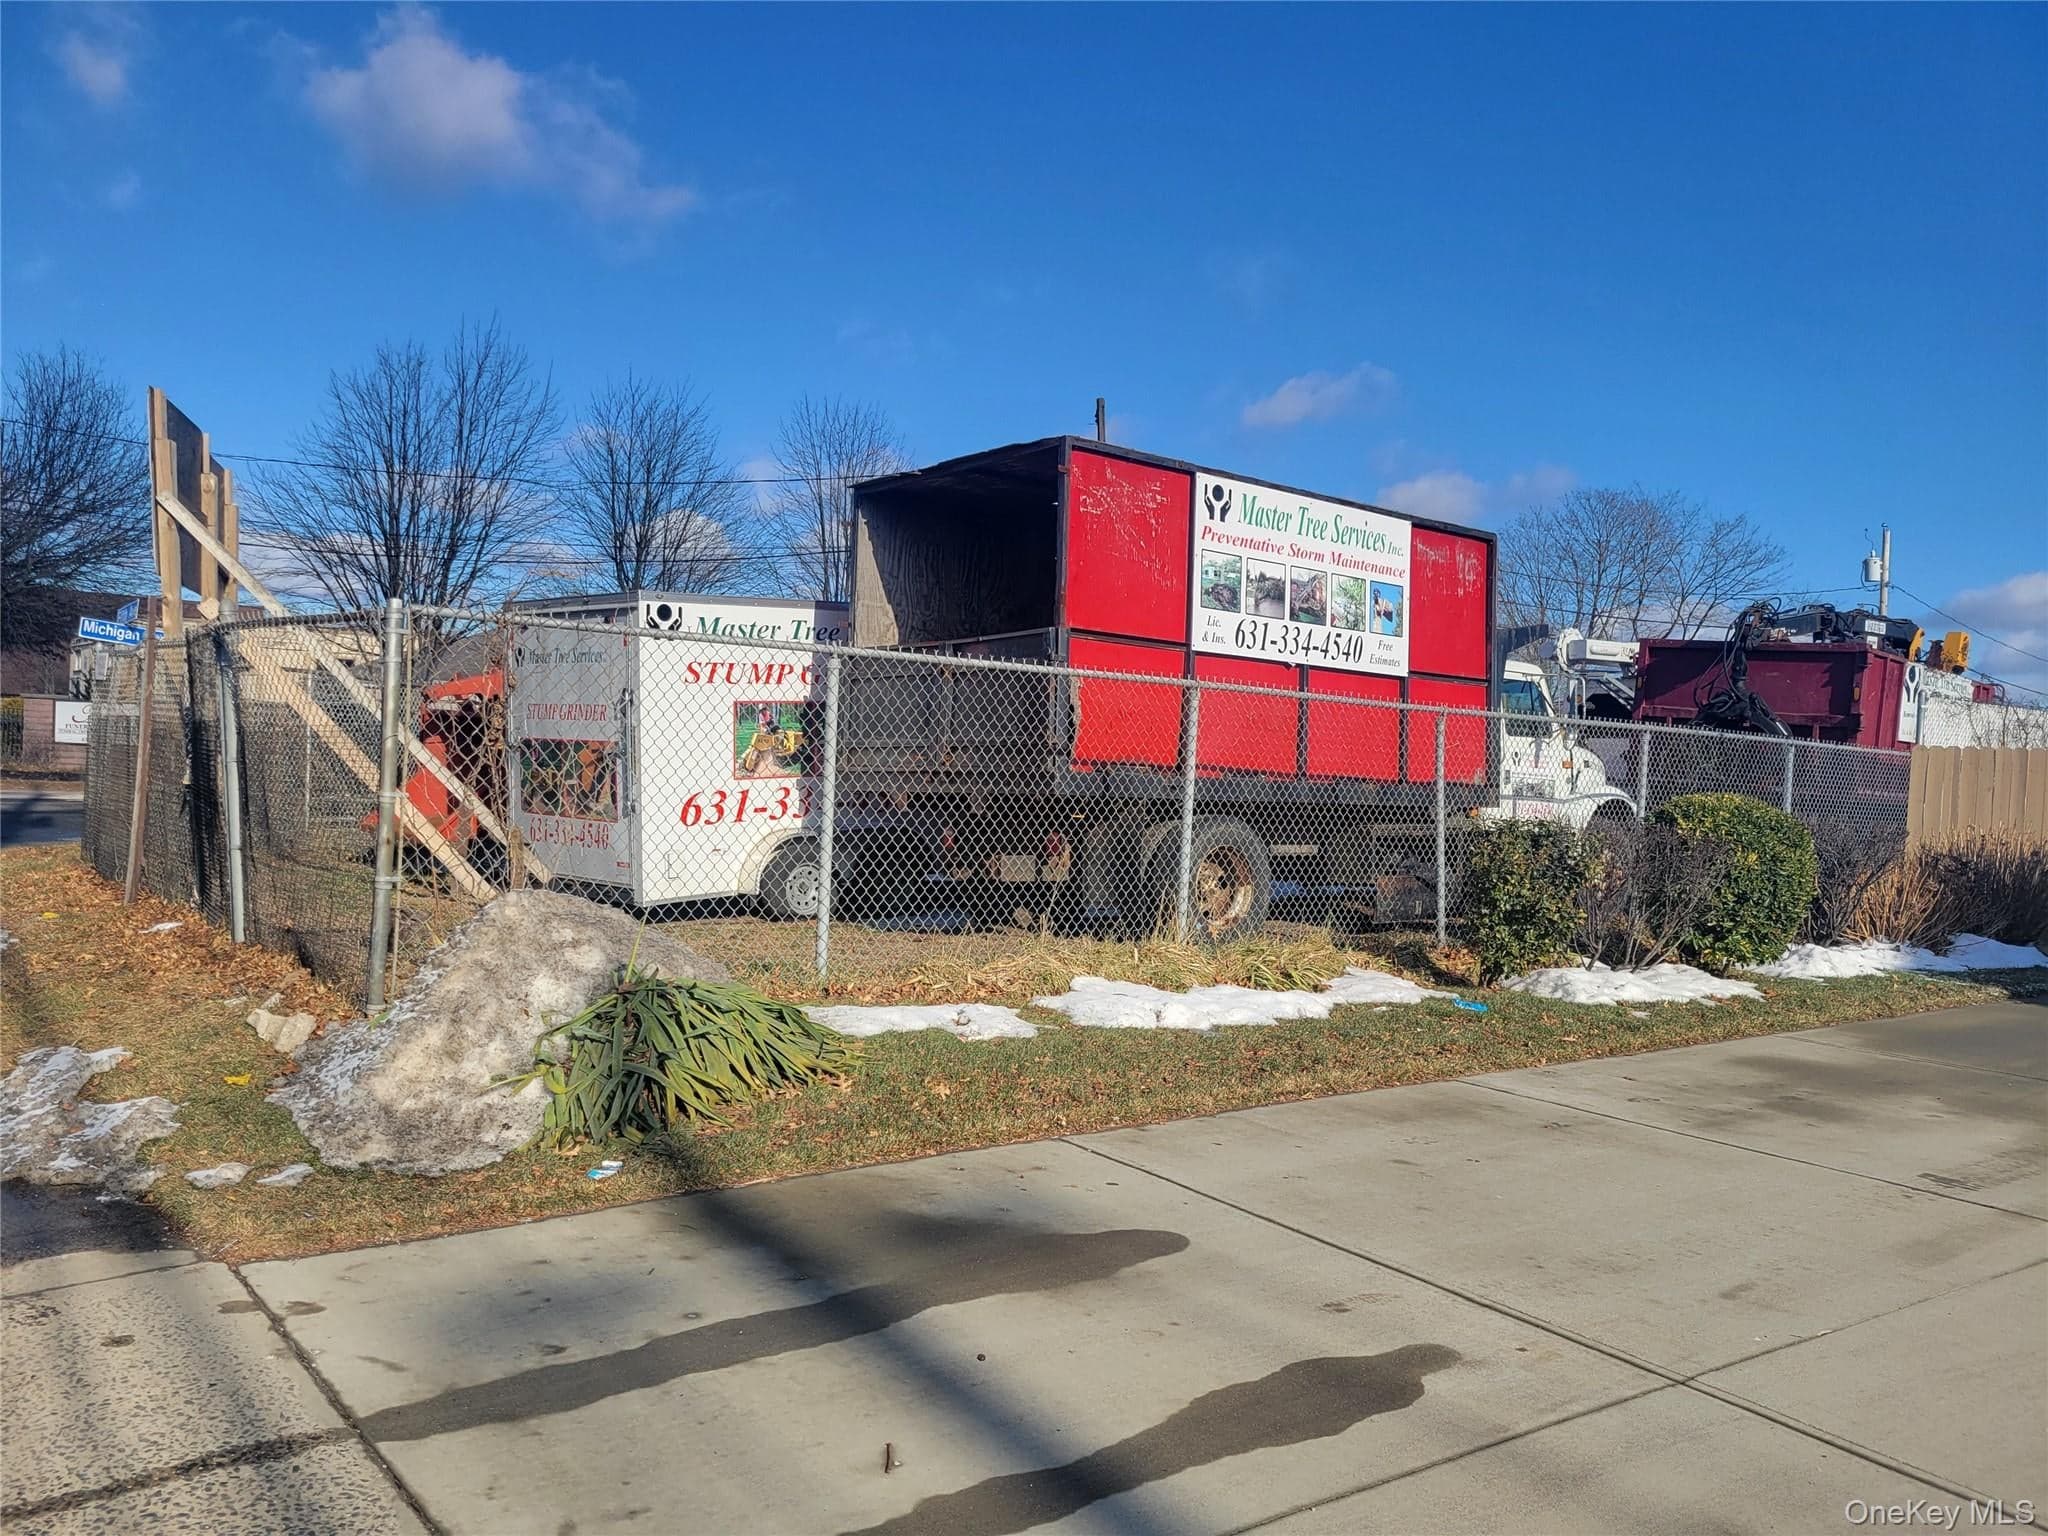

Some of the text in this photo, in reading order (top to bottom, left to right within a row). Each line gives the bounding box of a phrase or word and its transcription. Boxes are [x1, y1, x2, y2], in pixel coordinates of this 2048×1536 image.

[1238, 493, 1404, 557] Master Tree Services Inc.
[1201, 525, 1406, 579] Preventative Storm Maintenance
[83, 619, 140, 641] Michigan
[696, 616, 841, 642] Master Tree
[1206, 614, 1222, 628] Lic.
[1201, 631, 1226, 645] & Ins.
[1235, 618, 1364, 664] 631-334-4540
[1377, 640, 1394, 652] Free
[1369, 653, 1401, 668] Estimates
[684, 661, 794, 686] STUMP
[527, 703, 607, 721] STUMP GRINDER
